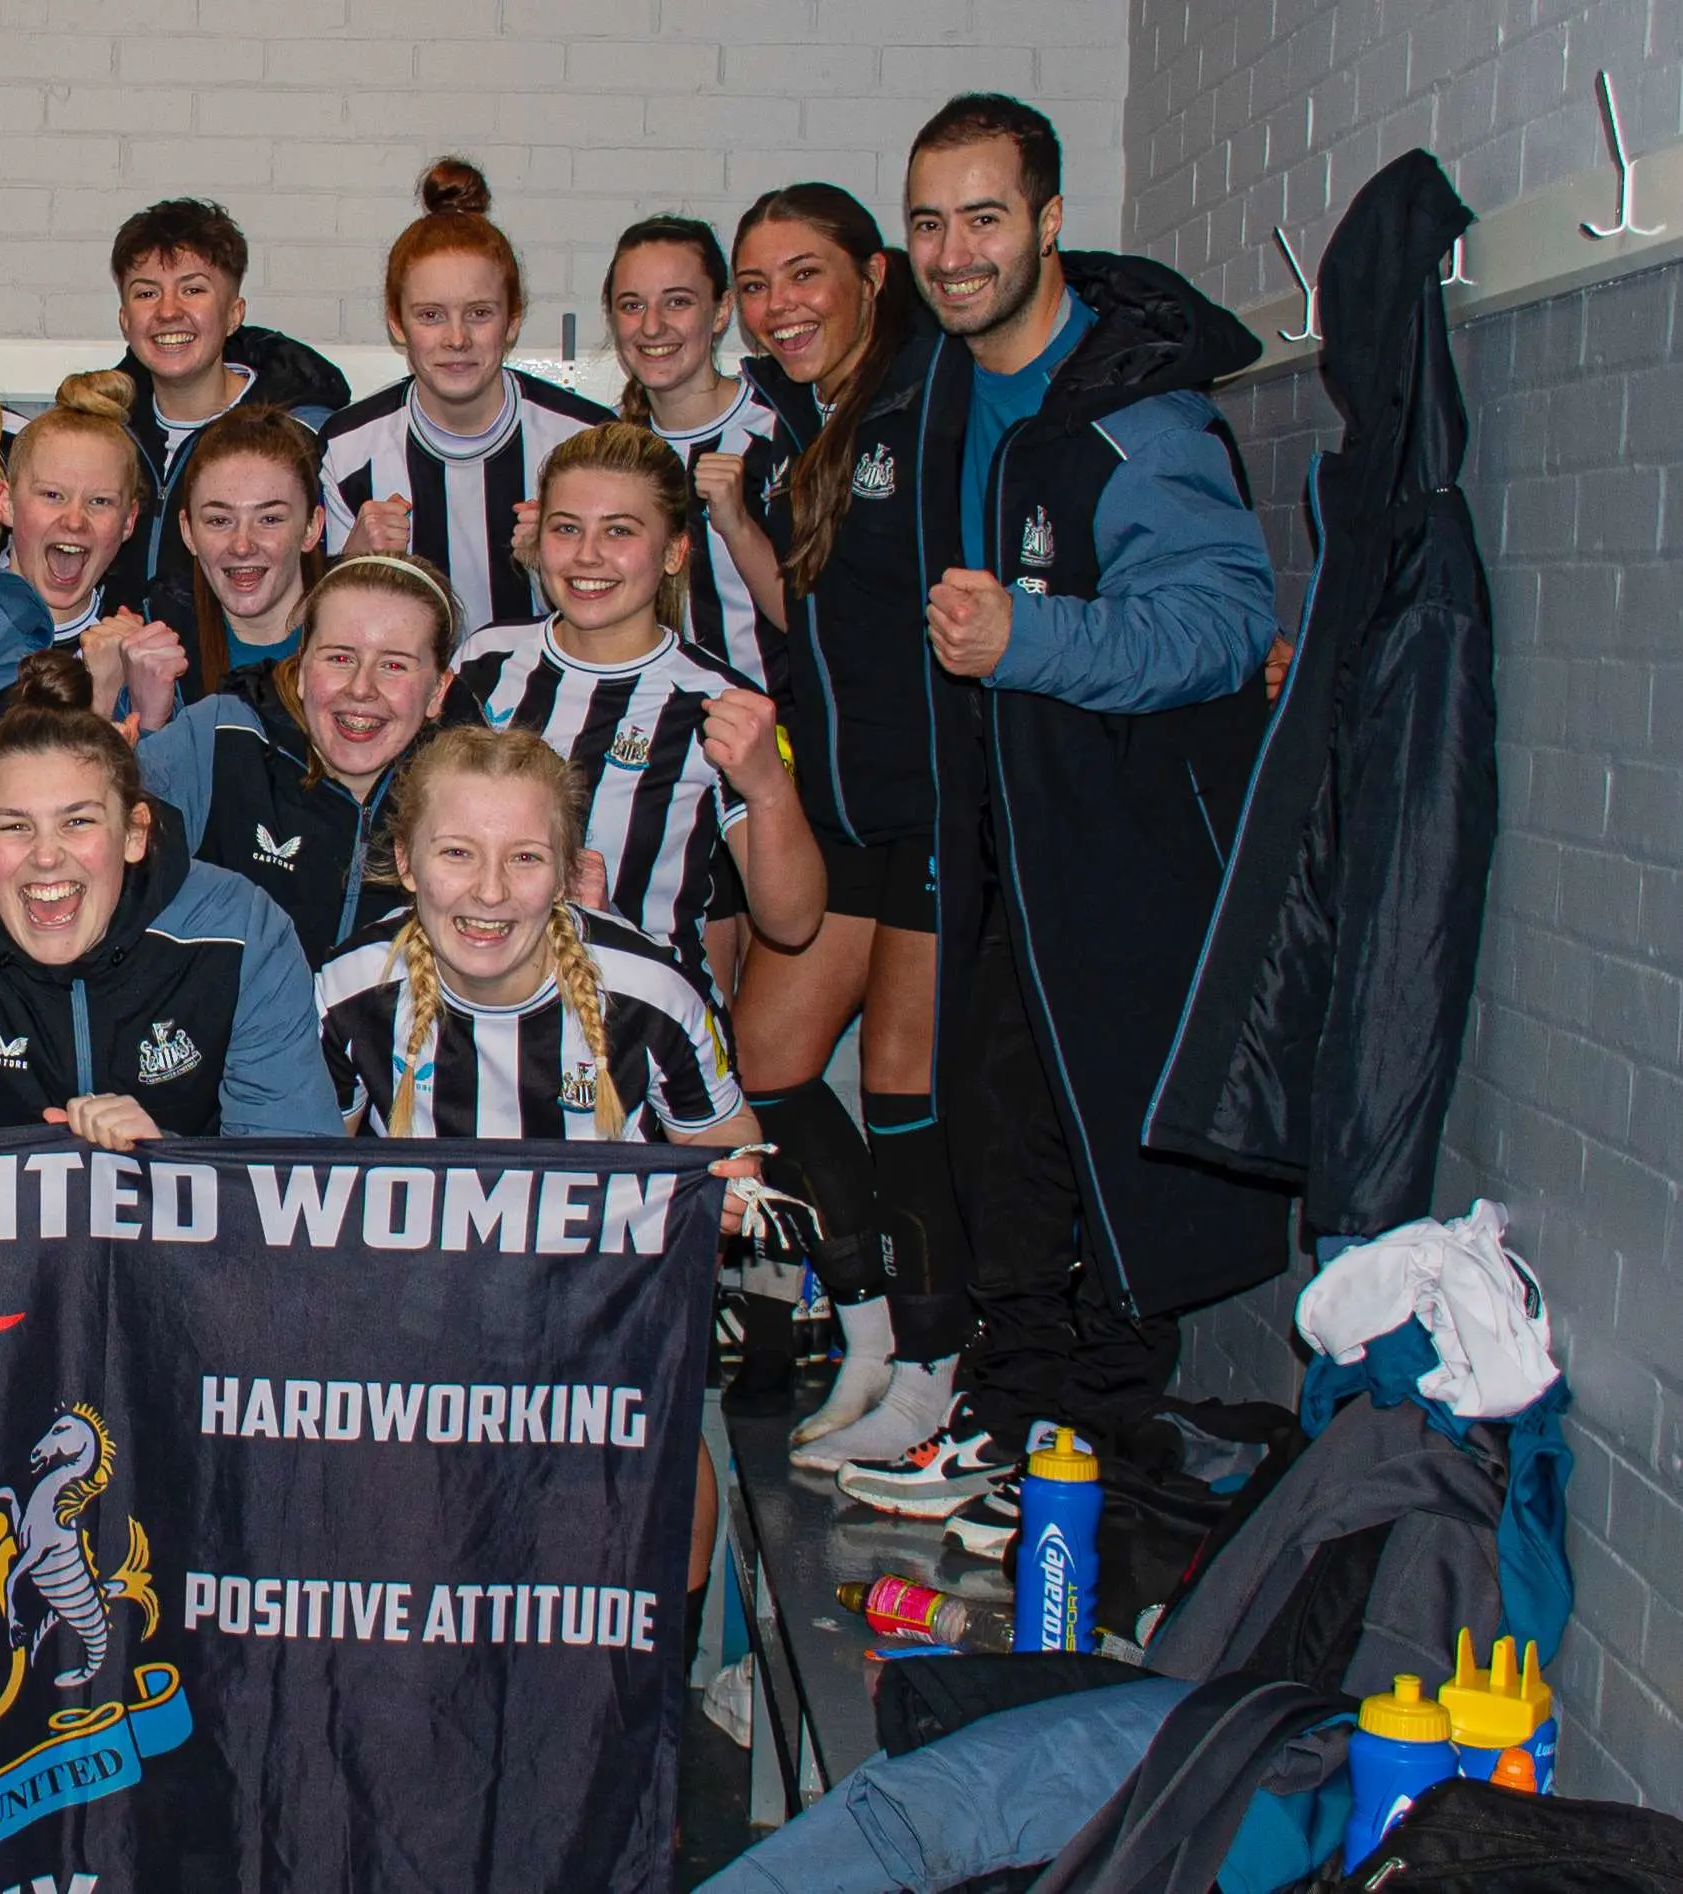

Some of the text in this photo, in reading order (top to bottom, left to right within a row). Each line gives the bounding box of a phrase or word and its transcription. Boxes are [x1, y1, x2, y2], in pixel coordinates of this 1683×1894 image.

[247, 1164, 677, 1256] WOMEN
[200, 1375, 647, 1448] HARDWORKING
[183, 1571, 658, 1652] POSITIVE ATTITUDE
[1040, 1547, 1066, 1651] cozade
